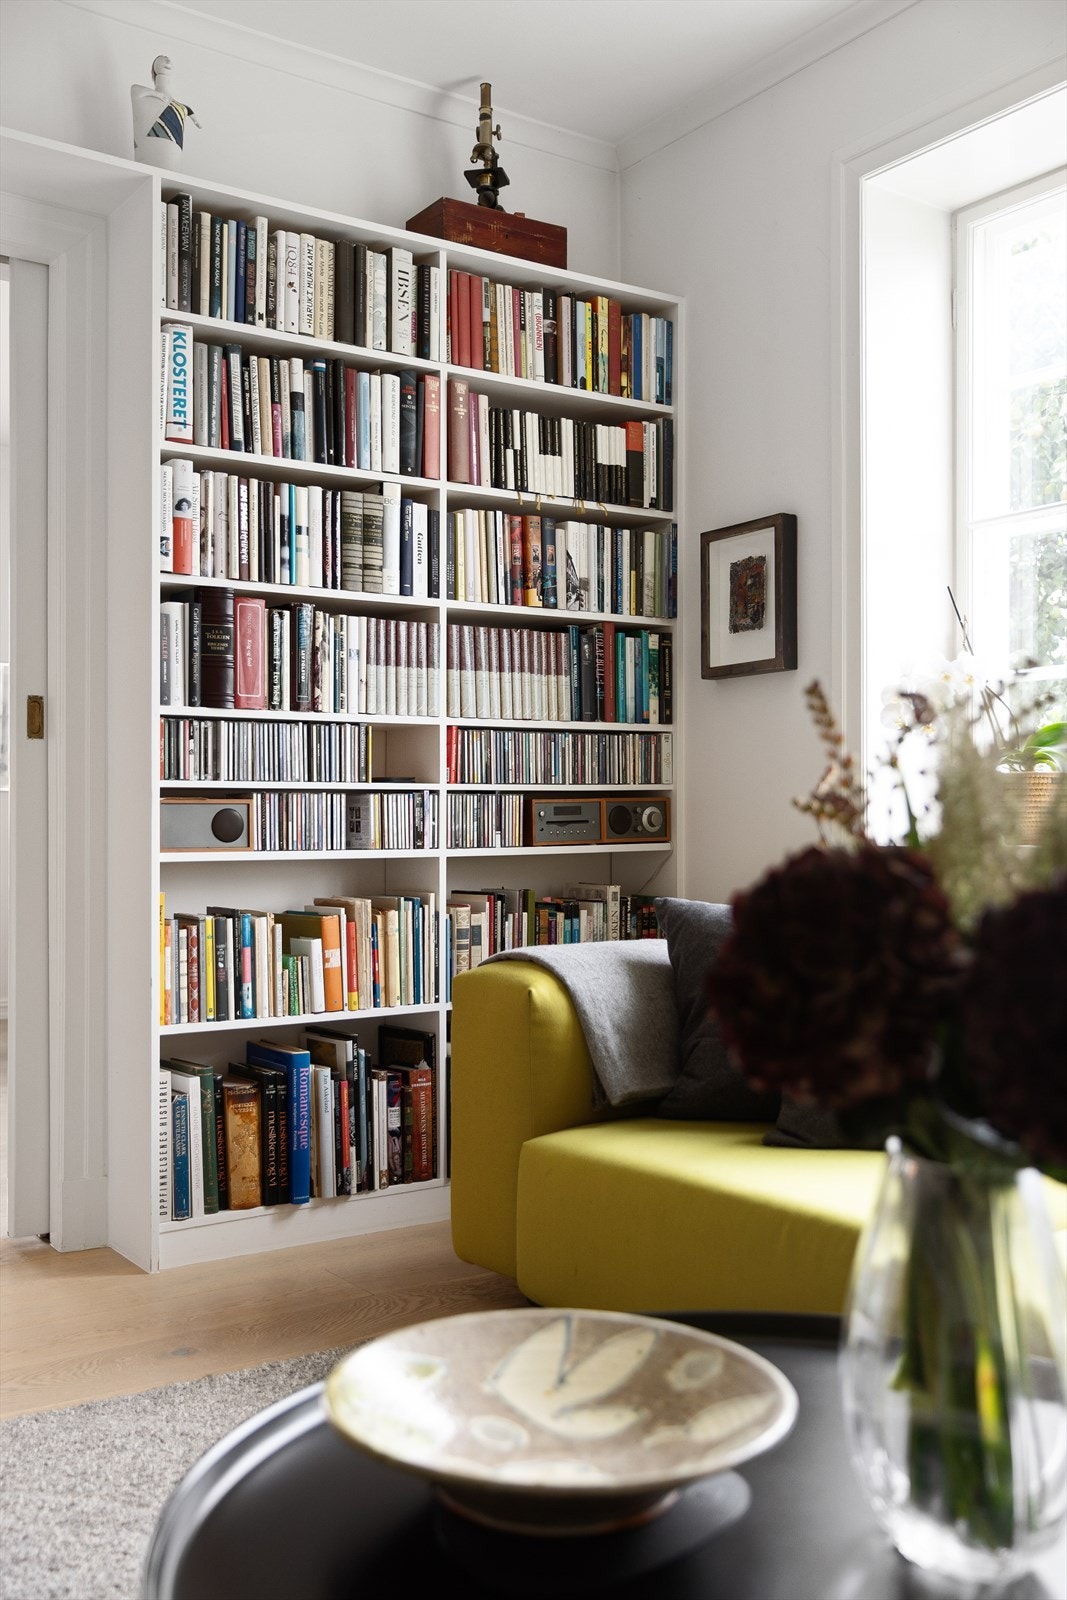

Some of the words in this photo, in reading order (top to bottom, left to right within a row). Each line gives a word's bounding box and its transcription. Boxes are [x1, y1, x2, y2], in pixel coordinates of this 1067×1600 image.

[182, 214, 190, 251] McEWAN
[286, 245, 297, 274] 1Q84
[398, 269, 409, 322] IBSEN
[535, 313, 543, 351] (BRANNEN)
[172, 331, 187, 429] KLOSTERET
[298, 1067, 309, 1149] Romanesque
[268, 1111, 276, 1160] musikken
[217, 1166, 225, 1180] og
[268, 1162, 276, 1176] og
[269, 1178, 276, 1187] vi
[280, 1162, 287, 1176] og
[281, 1178, 288, 1187] vi
[219, 1182, 226, 1191] vi
